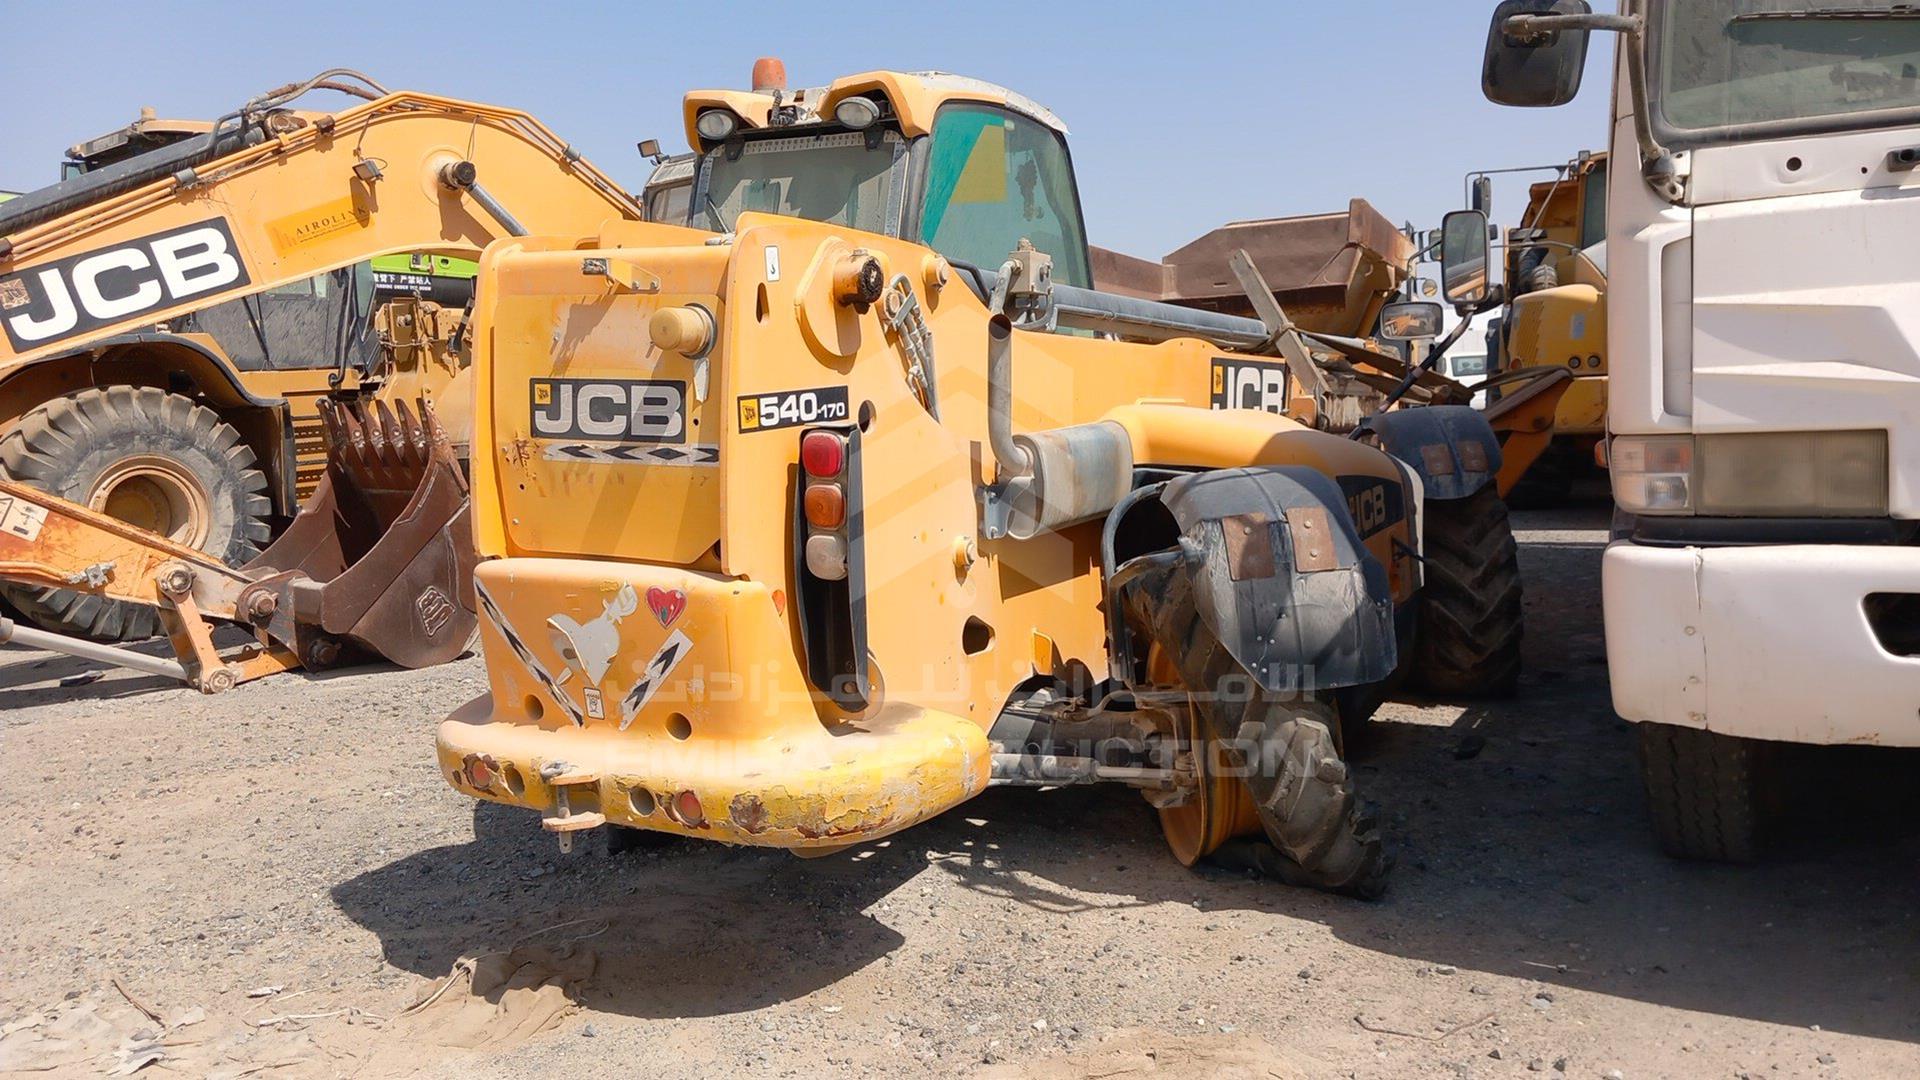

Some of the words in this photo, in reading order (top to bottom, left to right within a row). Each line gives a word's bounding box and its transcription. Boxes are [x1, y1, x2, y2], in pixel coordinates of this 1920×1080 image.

[295, 206, 367, 236] AIROLINK
[8, 227, 240, 341] JCB
[534, 383, 683, 437] JCB
[759, 391, 846, 427] 540-170
[1212, 366, 1285, 415] JCB
